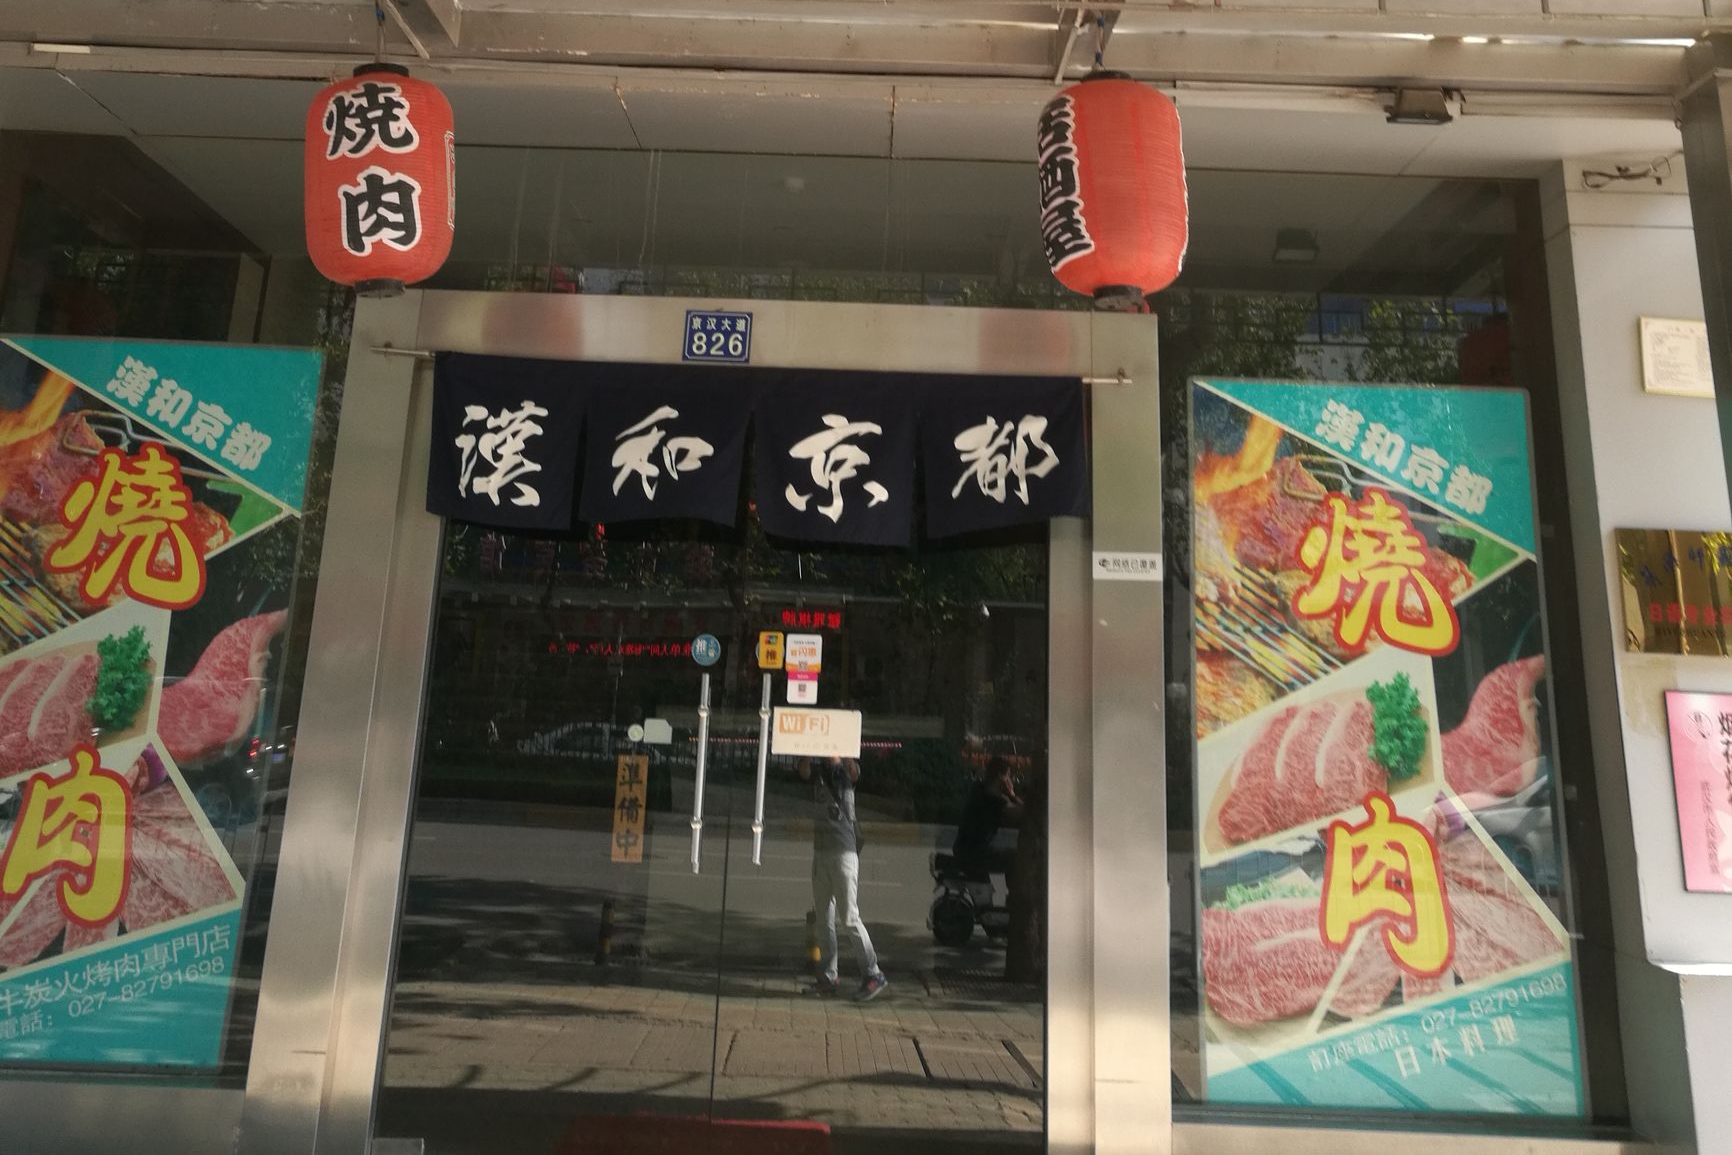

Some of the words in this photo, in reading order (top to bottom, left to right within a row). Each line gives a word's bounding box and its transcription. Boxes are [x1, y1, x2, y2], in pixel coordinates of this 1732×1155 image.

[691, 316, 747, 332] 京汉大道
[692, 332, 743, 356] 826
[106, 355, 272, 471] 漢和京都
[454, 400, 1061, 524] 漢和京都
[1315, 398, 1494, 516] 漢和京都
[68, 956, 225, 1018] 027-82791698
[1395, 1015, 1519, 1078] 日本料理
